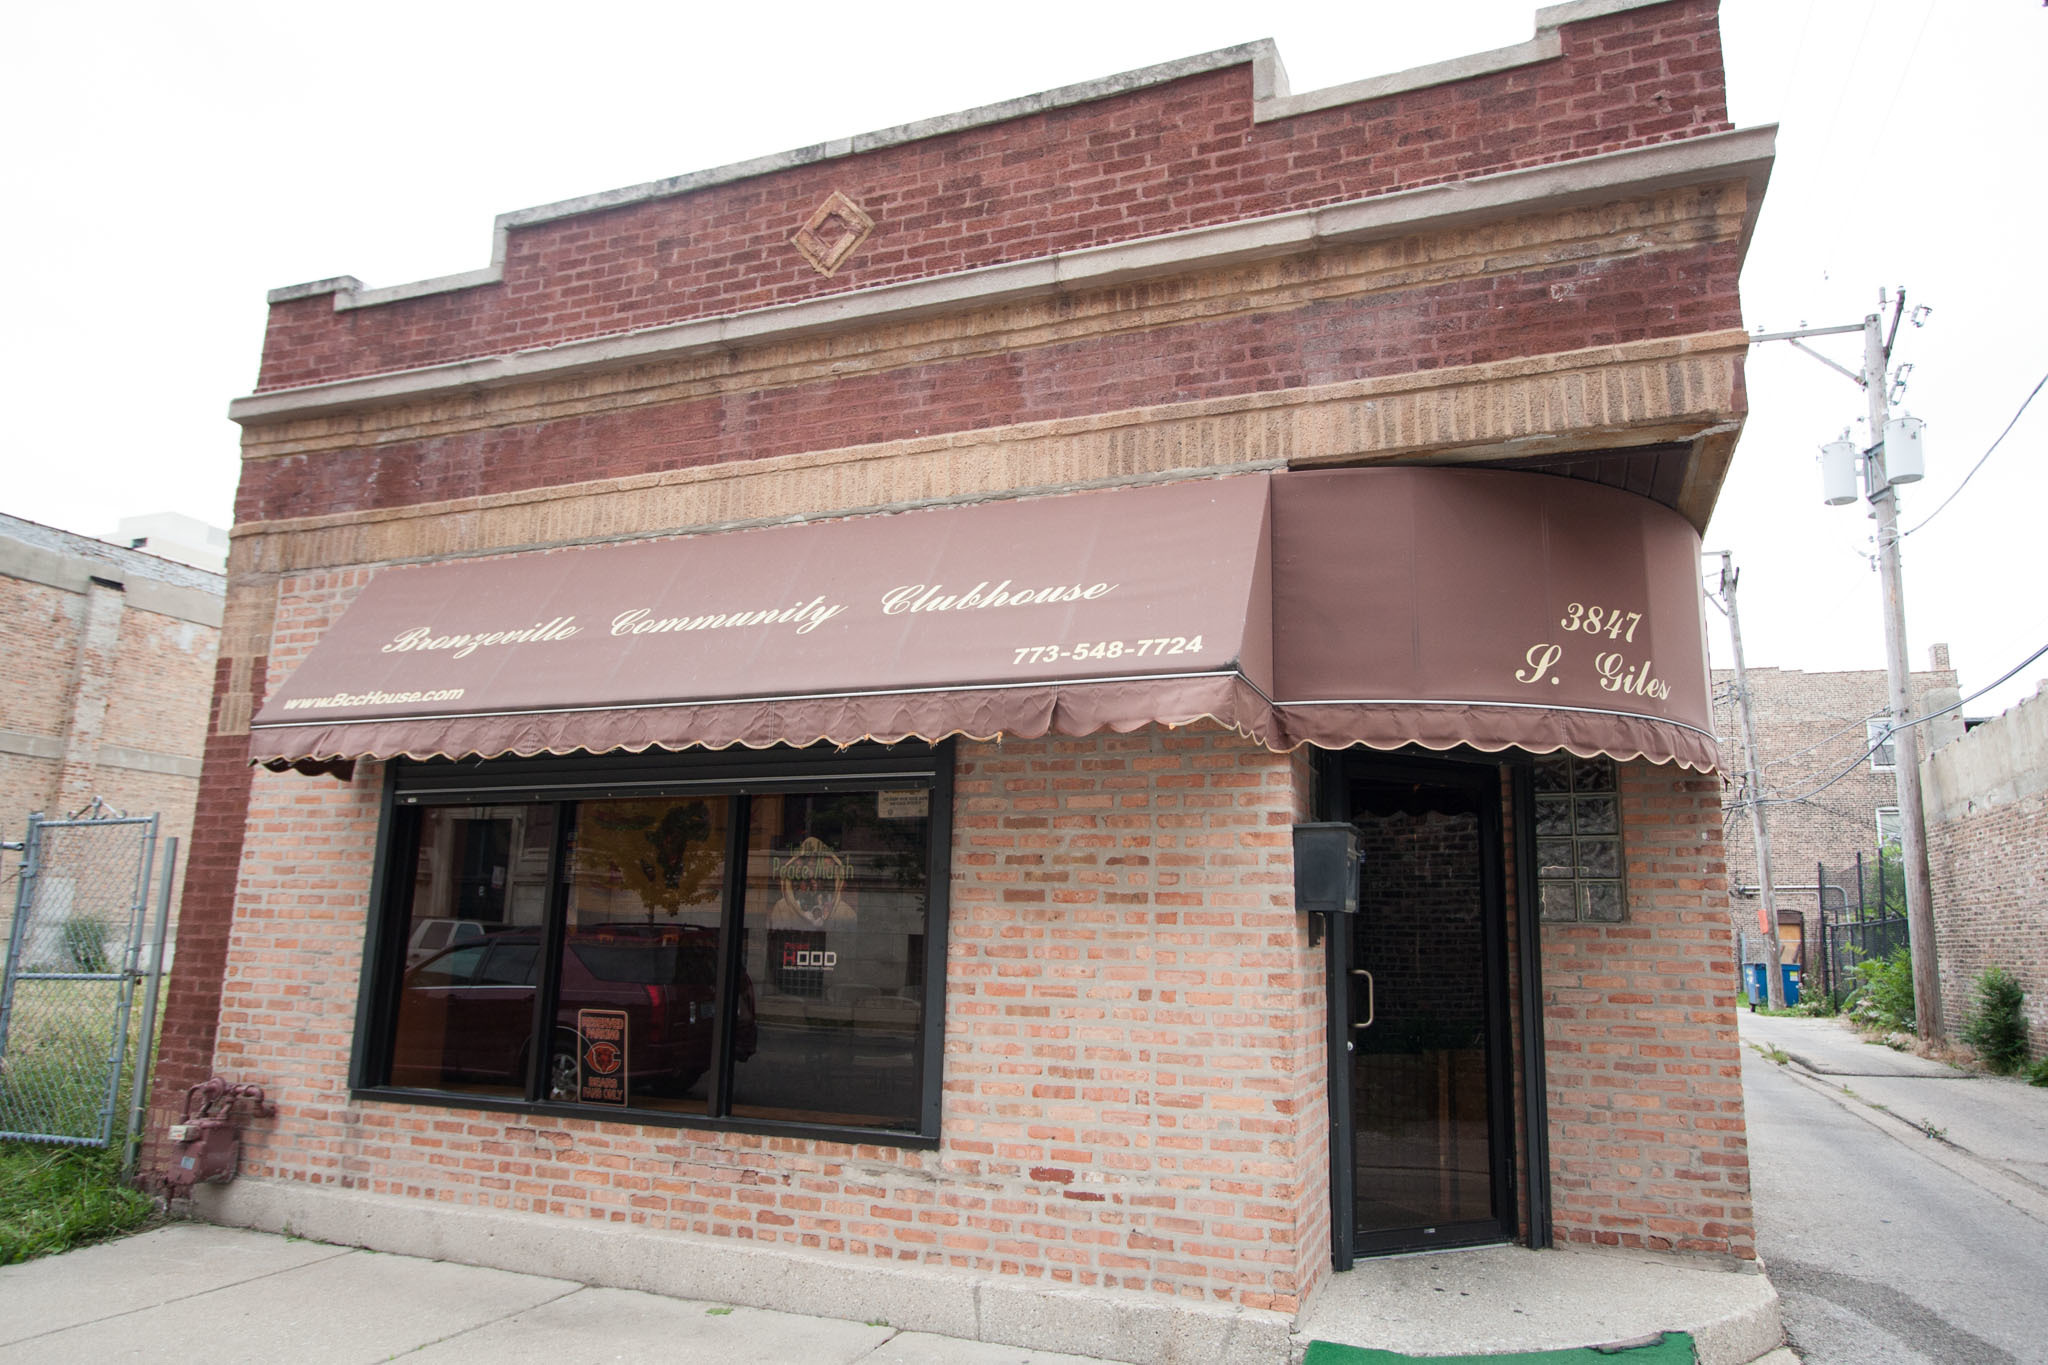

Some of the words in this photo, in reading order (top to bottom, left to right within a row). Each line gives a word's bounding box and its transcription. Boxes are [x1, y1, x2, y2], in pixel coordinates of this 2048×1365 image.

[382, 615, 584, 659] Bronzeville
[610, 595, 849, 636] Community
[881, 579, 1120, 616] Clubhouse
[1560, 602, 1642, 643] 3847
[1012, 635, 1204, 665] 773-548-7724
[1515, 643, 1562, 685] S.
[1595, 651, 1672, 700] Giles
[283, 688, 466, 710] www.BccHouse.com
[772, 857, 809, 880] Peace
[783, 951, 837, 966] HOOD
